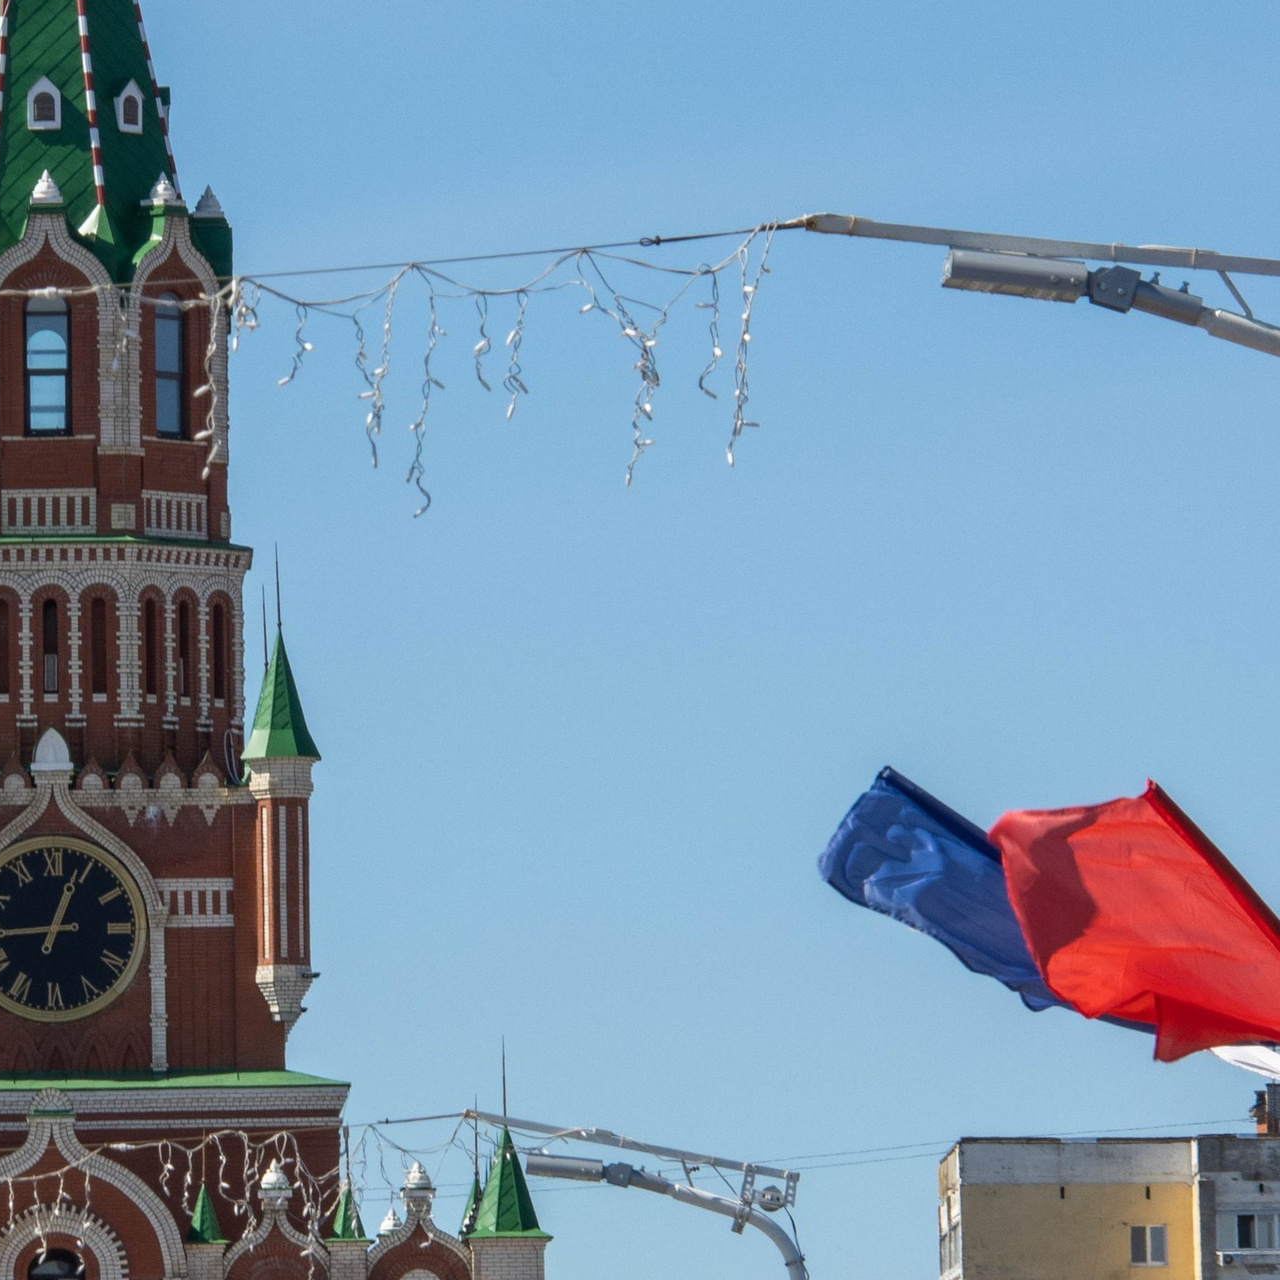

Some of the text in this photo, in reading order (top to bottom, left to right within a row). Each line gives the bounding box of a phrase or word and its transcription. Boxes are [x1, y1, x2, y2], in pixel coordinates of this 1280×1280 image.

[10, 859, 33, 887] XI
[44, 851, 63, 876] XII
[79, 861, 93, 884] I
[98, 887, 121, 906] II
[107, 922, 131, 935] III
[10, 971, 32, 1001] VII
[48, 982, 63, 1007] VI
[81, 975, 99, 998] V
